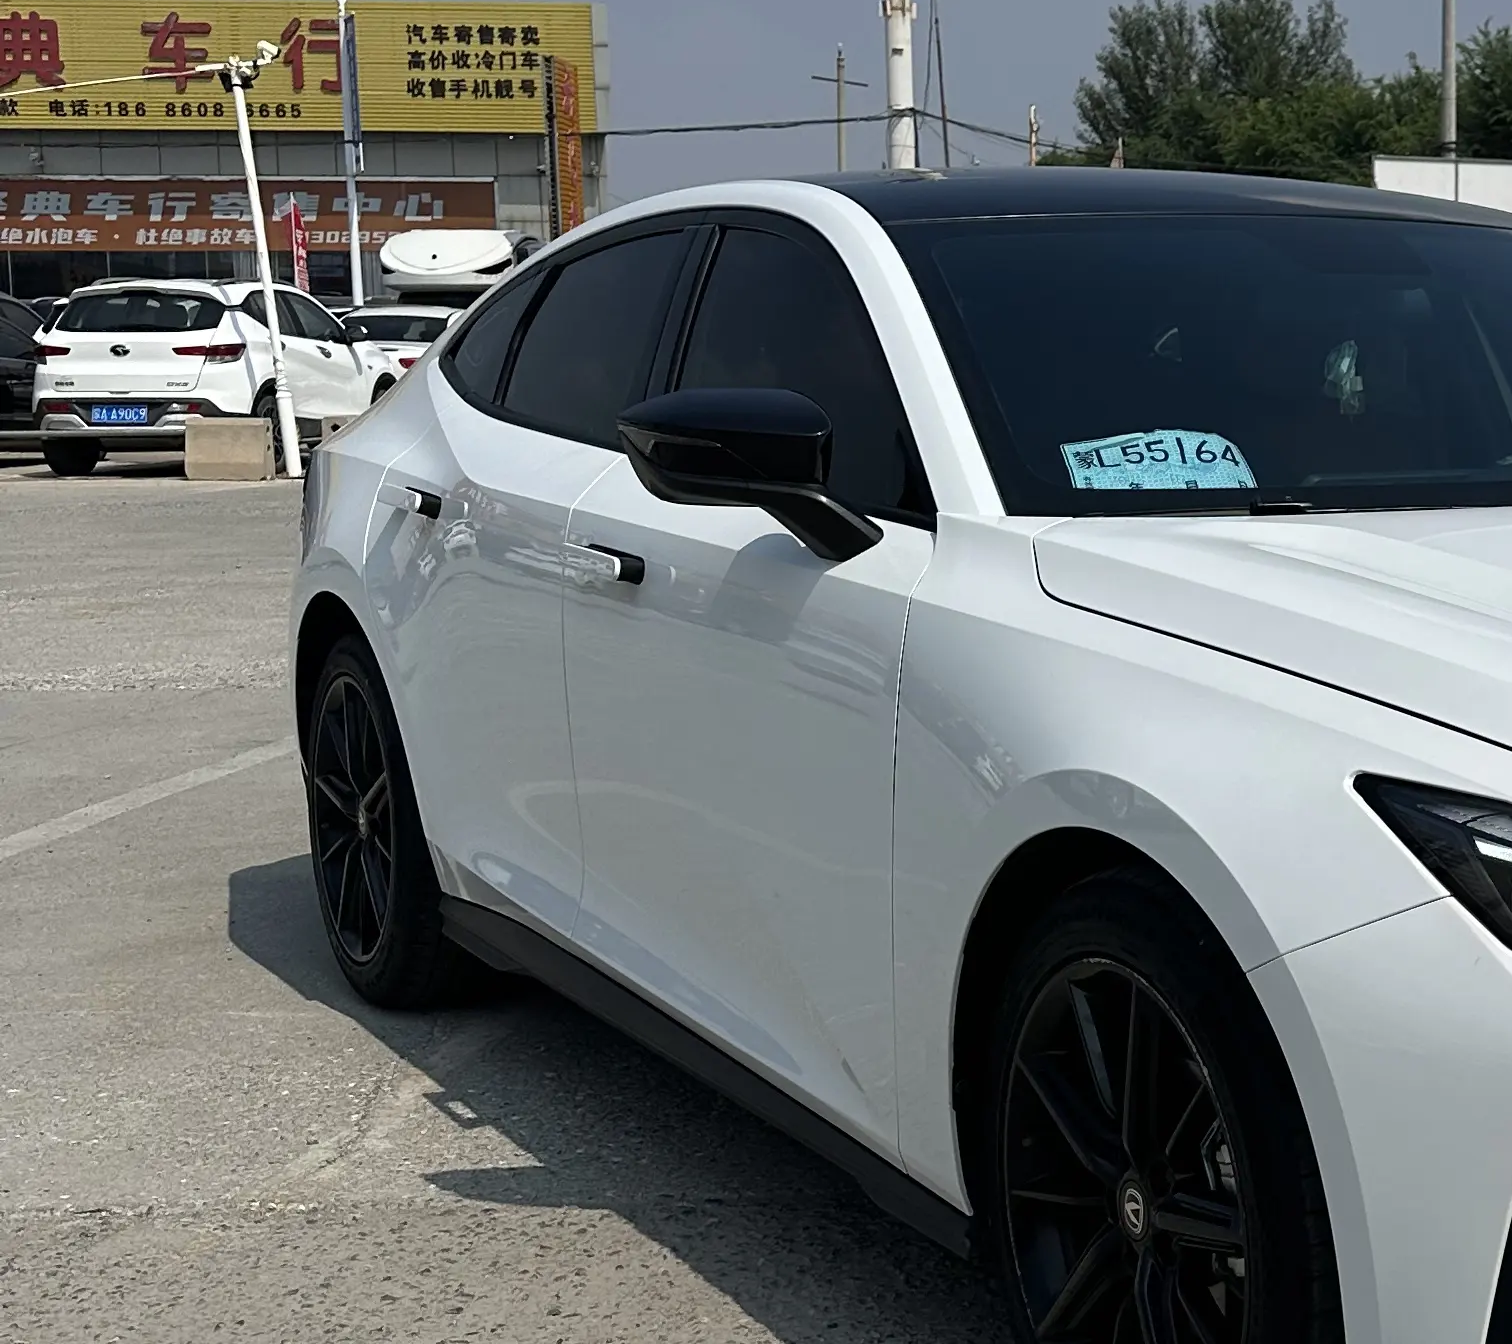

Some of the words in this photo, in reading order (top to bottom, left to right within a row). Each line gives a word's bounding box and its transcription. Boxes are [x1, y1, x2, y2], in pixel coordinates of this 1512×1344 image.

[405, 24, 541, 46] 汽车寄售寄卖
[406, 50, 540, 71] 高价收冷门车
[406, 78, 538, 99] 收售手机靓号
[165, 102, 224, 117] 8608
[0, 191, 444, 222] 典车行寄售中心
[1072, 436, 1240, 470] 蒙L55164
